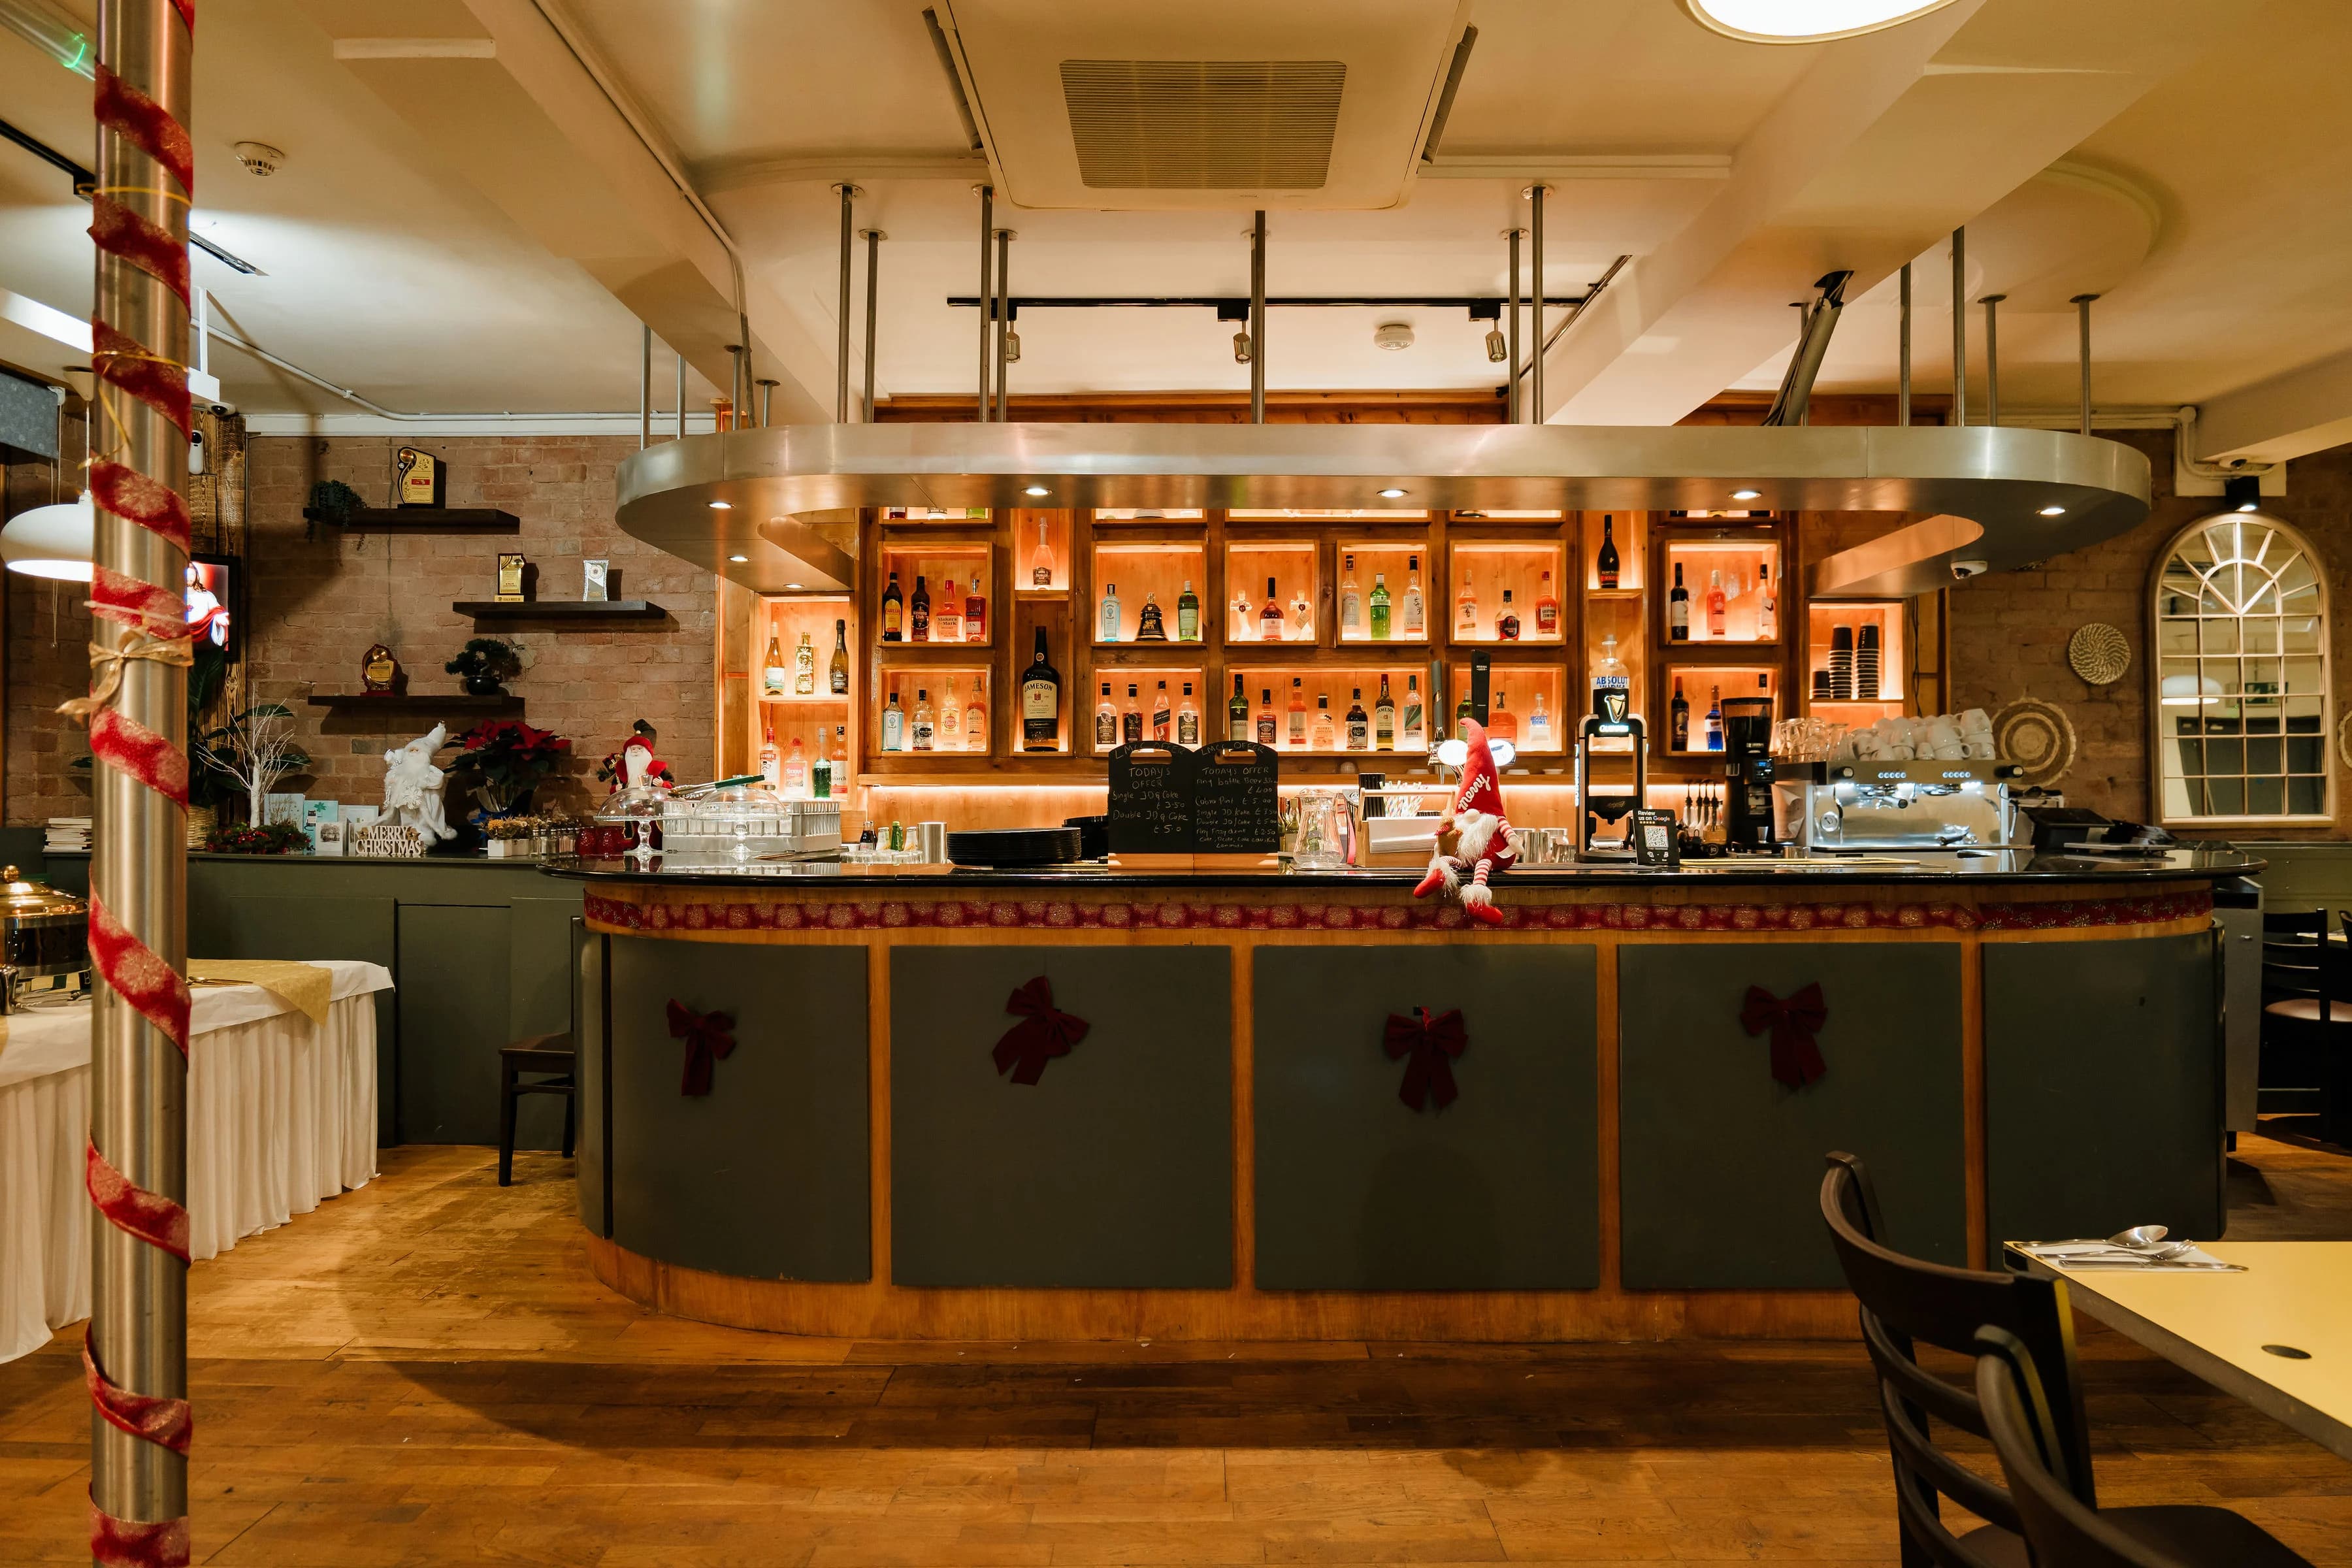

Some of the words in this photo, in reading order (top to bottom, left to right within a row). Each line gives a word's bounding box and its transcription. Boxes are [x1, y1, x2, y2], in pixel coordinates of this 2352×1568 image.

[1597, 676, 1628, 685] ABSOLUT
[1024, 683, 1053, 693] JAMESON
[1132, 779, 1164, 789] OFFER
[1113, 791, 1134, 803] Single
[1113, 810, 1141, 821] Double
[368, 825, 409, 841] MERRY
[355, 840, 422, 855] CHRISTMAS
